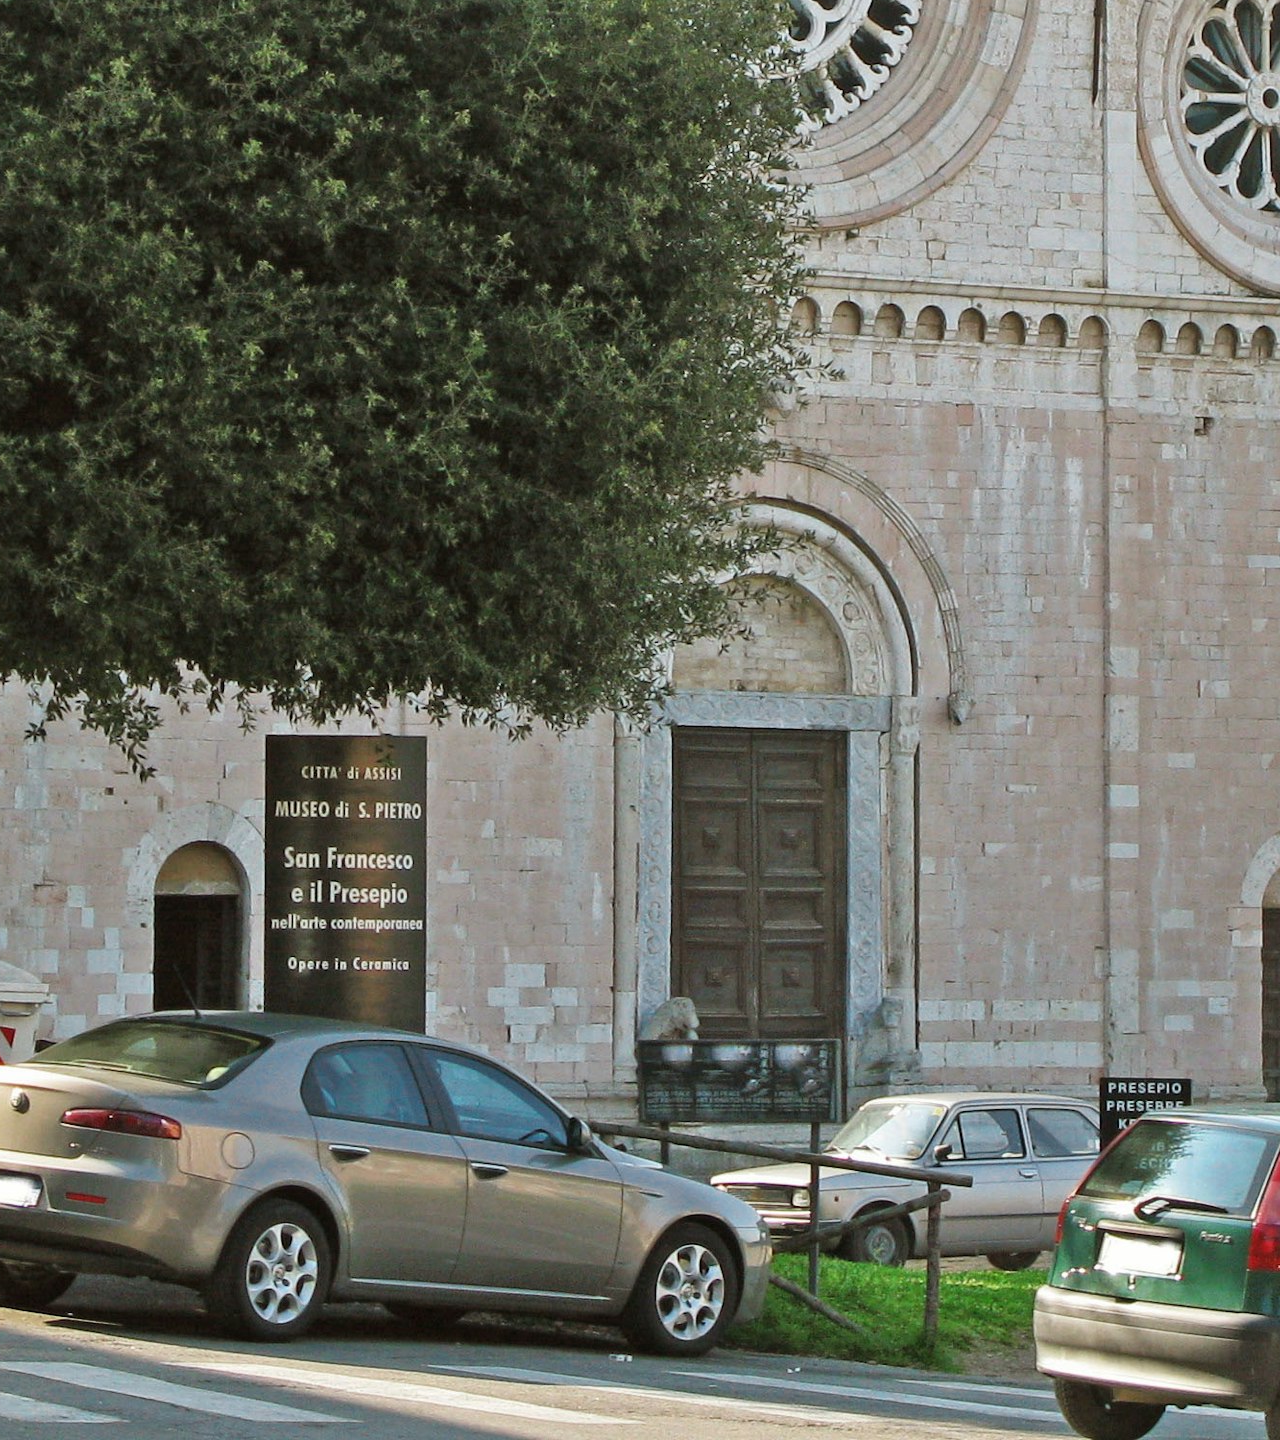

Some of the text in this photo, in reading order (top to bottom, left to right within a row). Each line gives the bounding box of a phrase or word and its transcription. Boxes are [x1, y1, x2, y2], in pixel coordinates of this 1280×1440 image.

[301, 766, 401, 780] CITTA' di ASSISI
[275, 801, 422, 819] MUSEO di S. PIETRO
[284, 846, 413, 869] San Francesco
[291, 880, 407, 908] e il Presepio
[271, 914, 423, 933] nell'arte contemporanea
[288, 957, 409, 972] Opere in Ceramica
[1108, 1082, 1182, 1094] PRESEPIO
